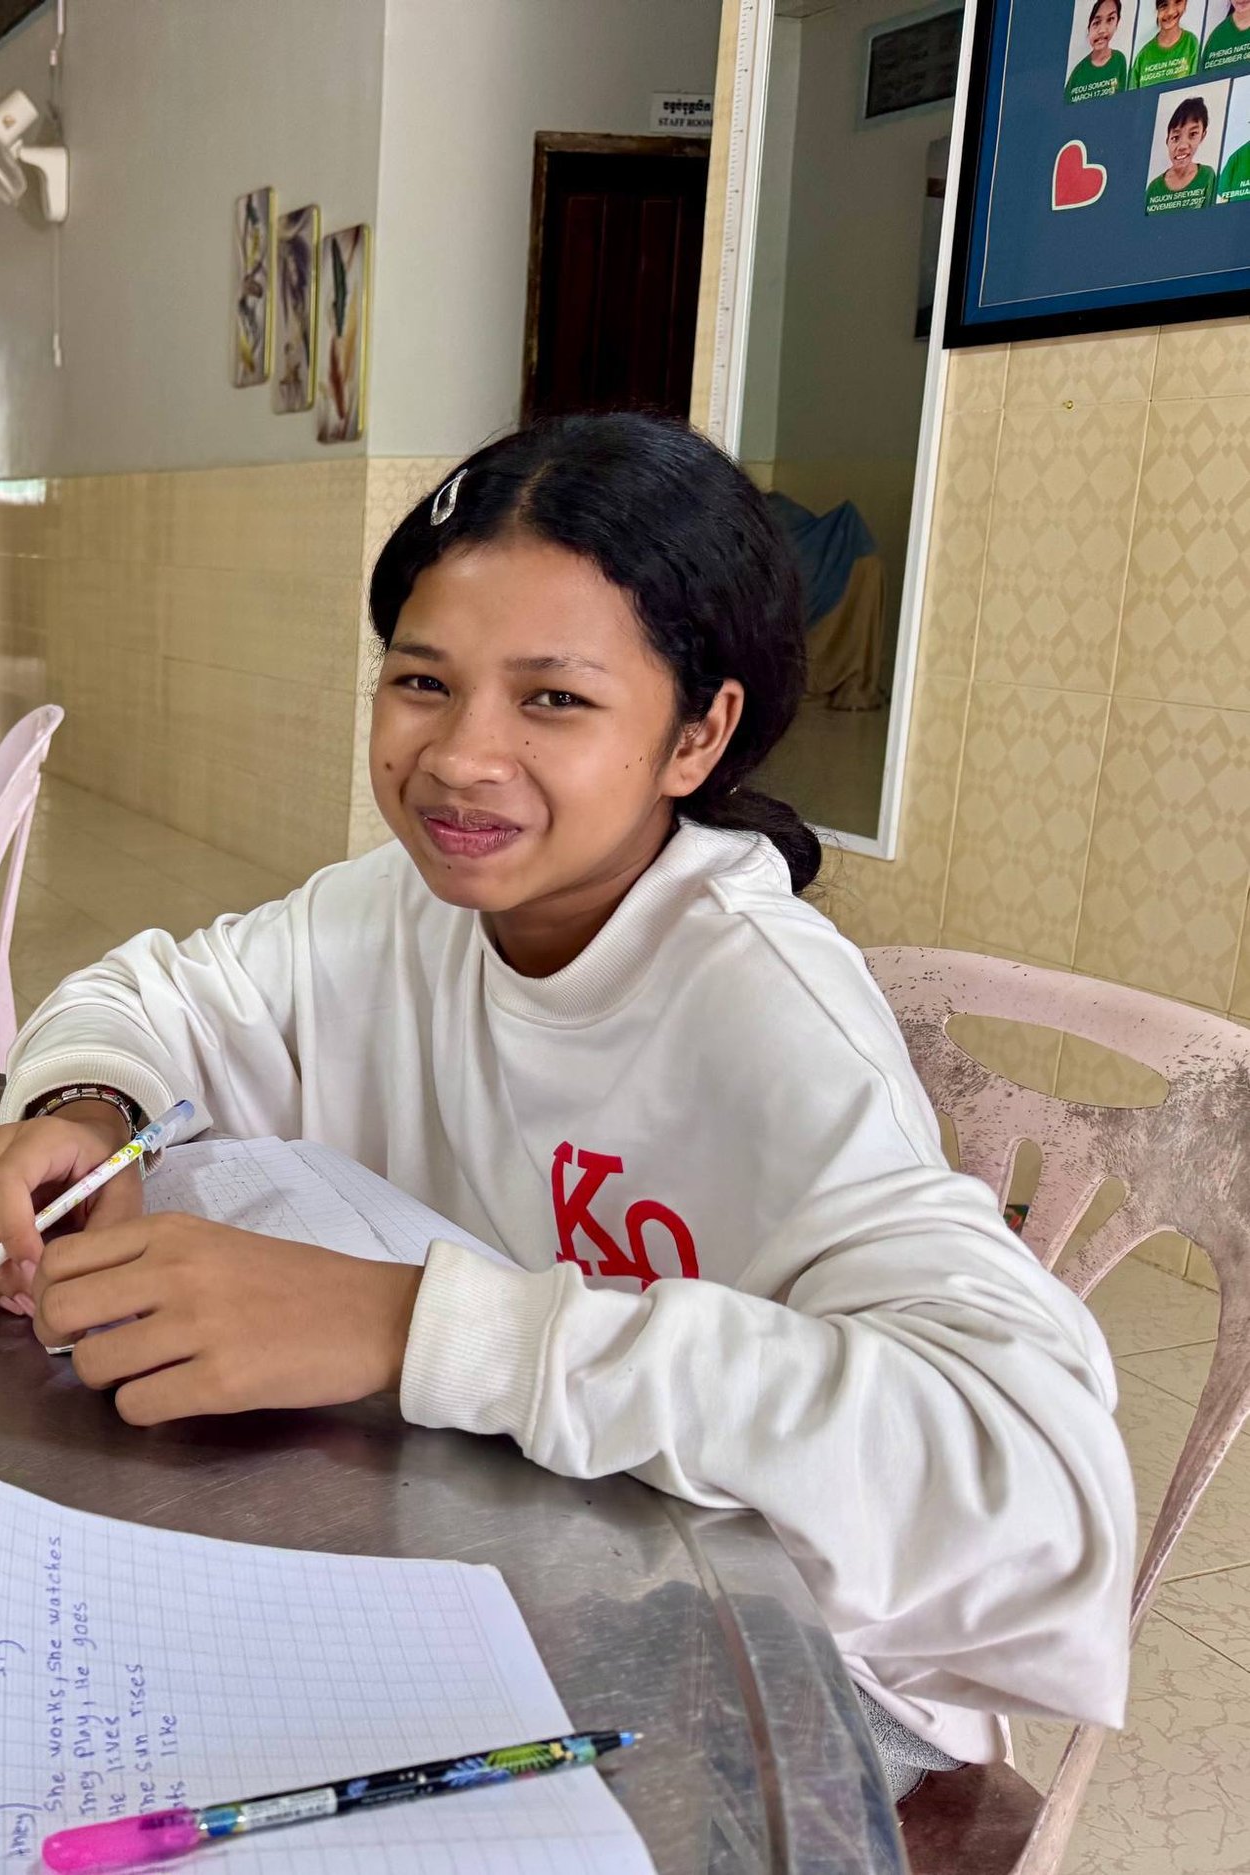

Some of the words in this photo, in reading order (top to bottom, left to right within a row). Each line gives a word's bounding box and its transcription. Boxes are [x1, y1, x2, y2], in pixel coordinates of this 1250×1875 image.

[1139, 70, 1166, 81] AUGUST
[1204, 53, 1242, 69] DECEMBER
[1071, 92, 1093, 103] MARCH
[658, 117, 685, 127] STAFF
[1146, 200, 1182, 212] NOVEMBER
[45, 1535, 60, 1624] watches
[71, 1601, 97, 1648] goes
[76, 1666, 90, 1690] He
[128, 1663, 144, 1717] rises
[104, 1715, 125, 1771] lives
[134, 1733, 152, 1774] sun
[157, 1714, 179, 1755] like
[43, 1771, 66, 1812] She
[77, 1770, 103, 1815] They
[107, 1793, 126, 1815] He
